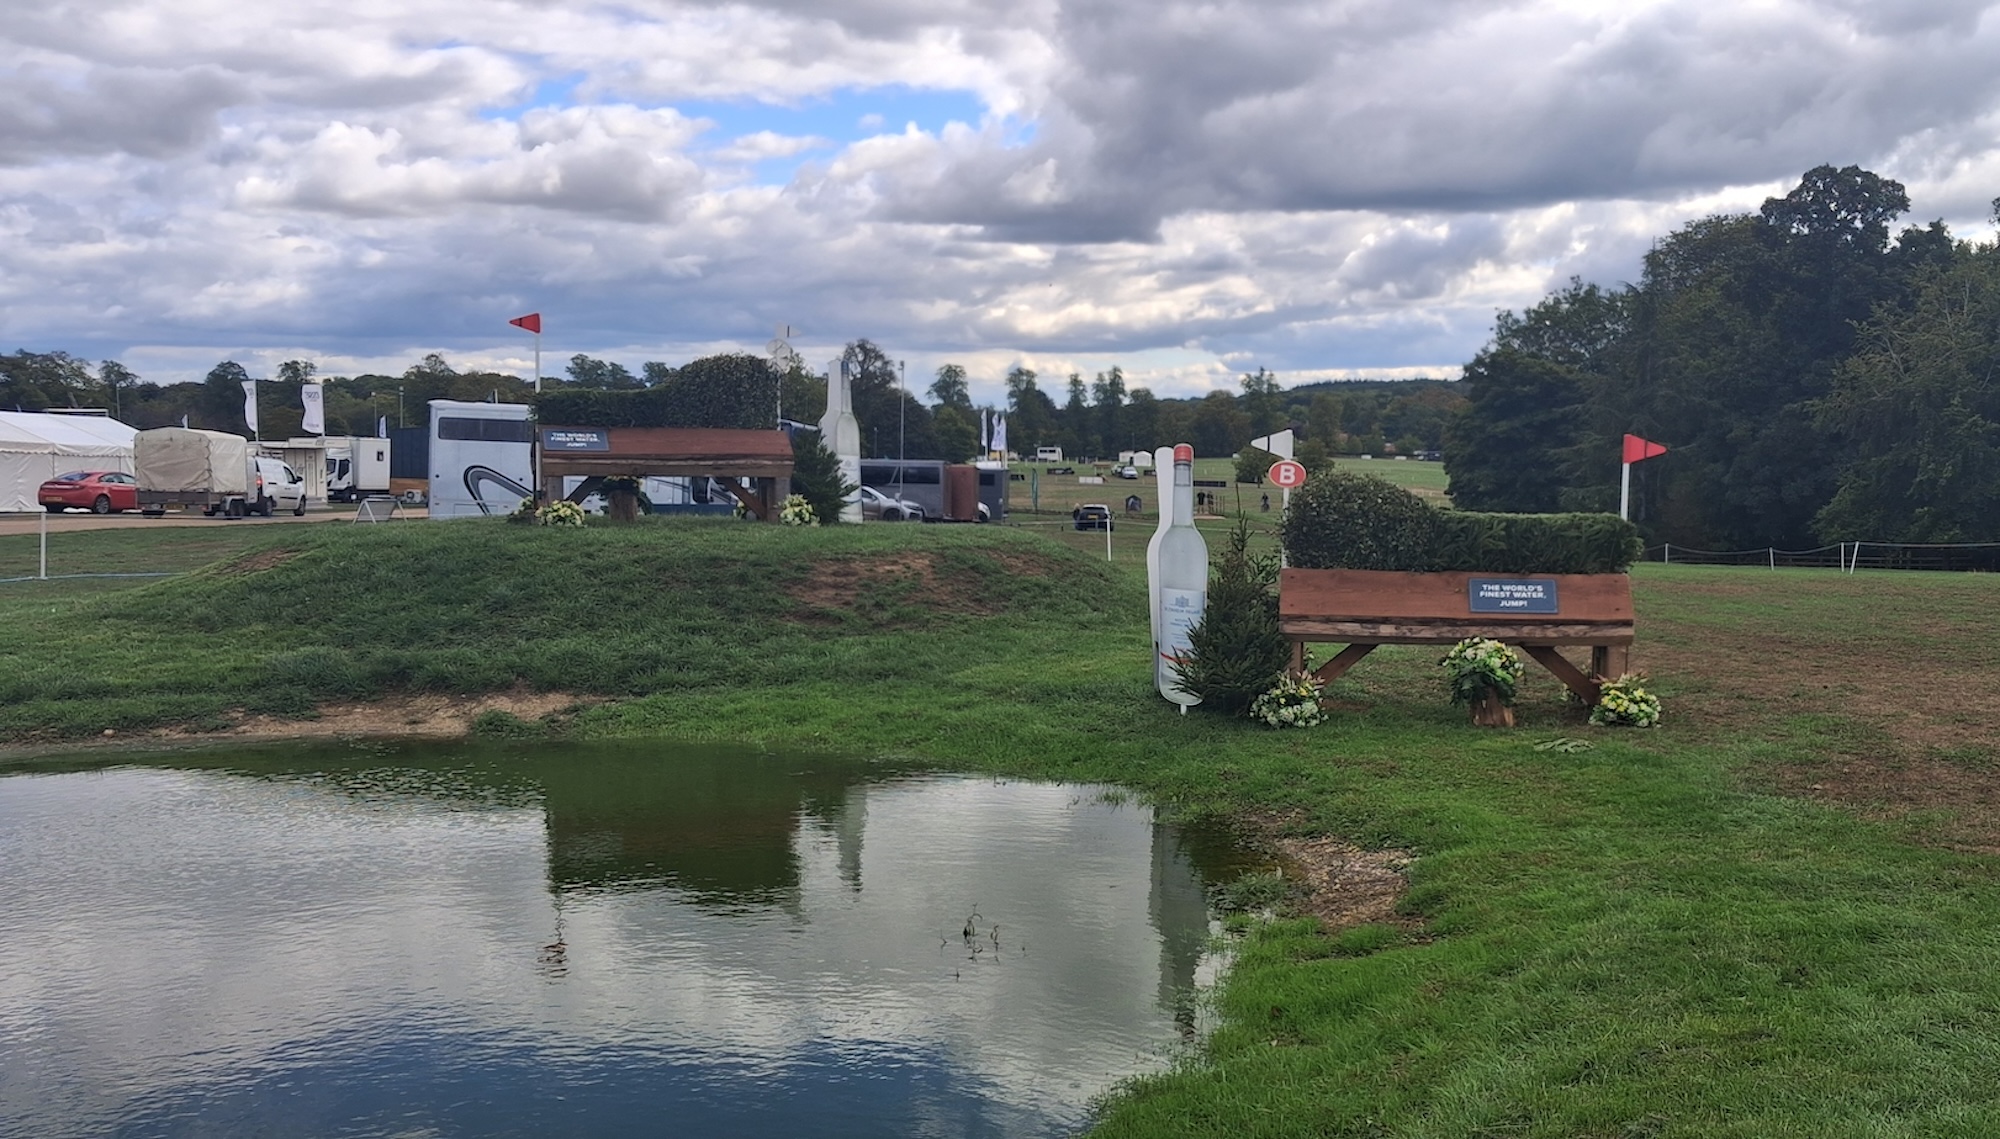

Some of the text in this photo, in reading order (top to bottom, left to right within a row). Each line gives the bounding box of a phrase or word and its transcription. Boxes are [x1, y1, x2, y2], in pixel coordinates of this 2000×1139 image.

[1280, 464, 1296, 484] B
[1502, 584, 1543, 592] WORLD'S
[1513, 591, 1547, 599] WATER,
